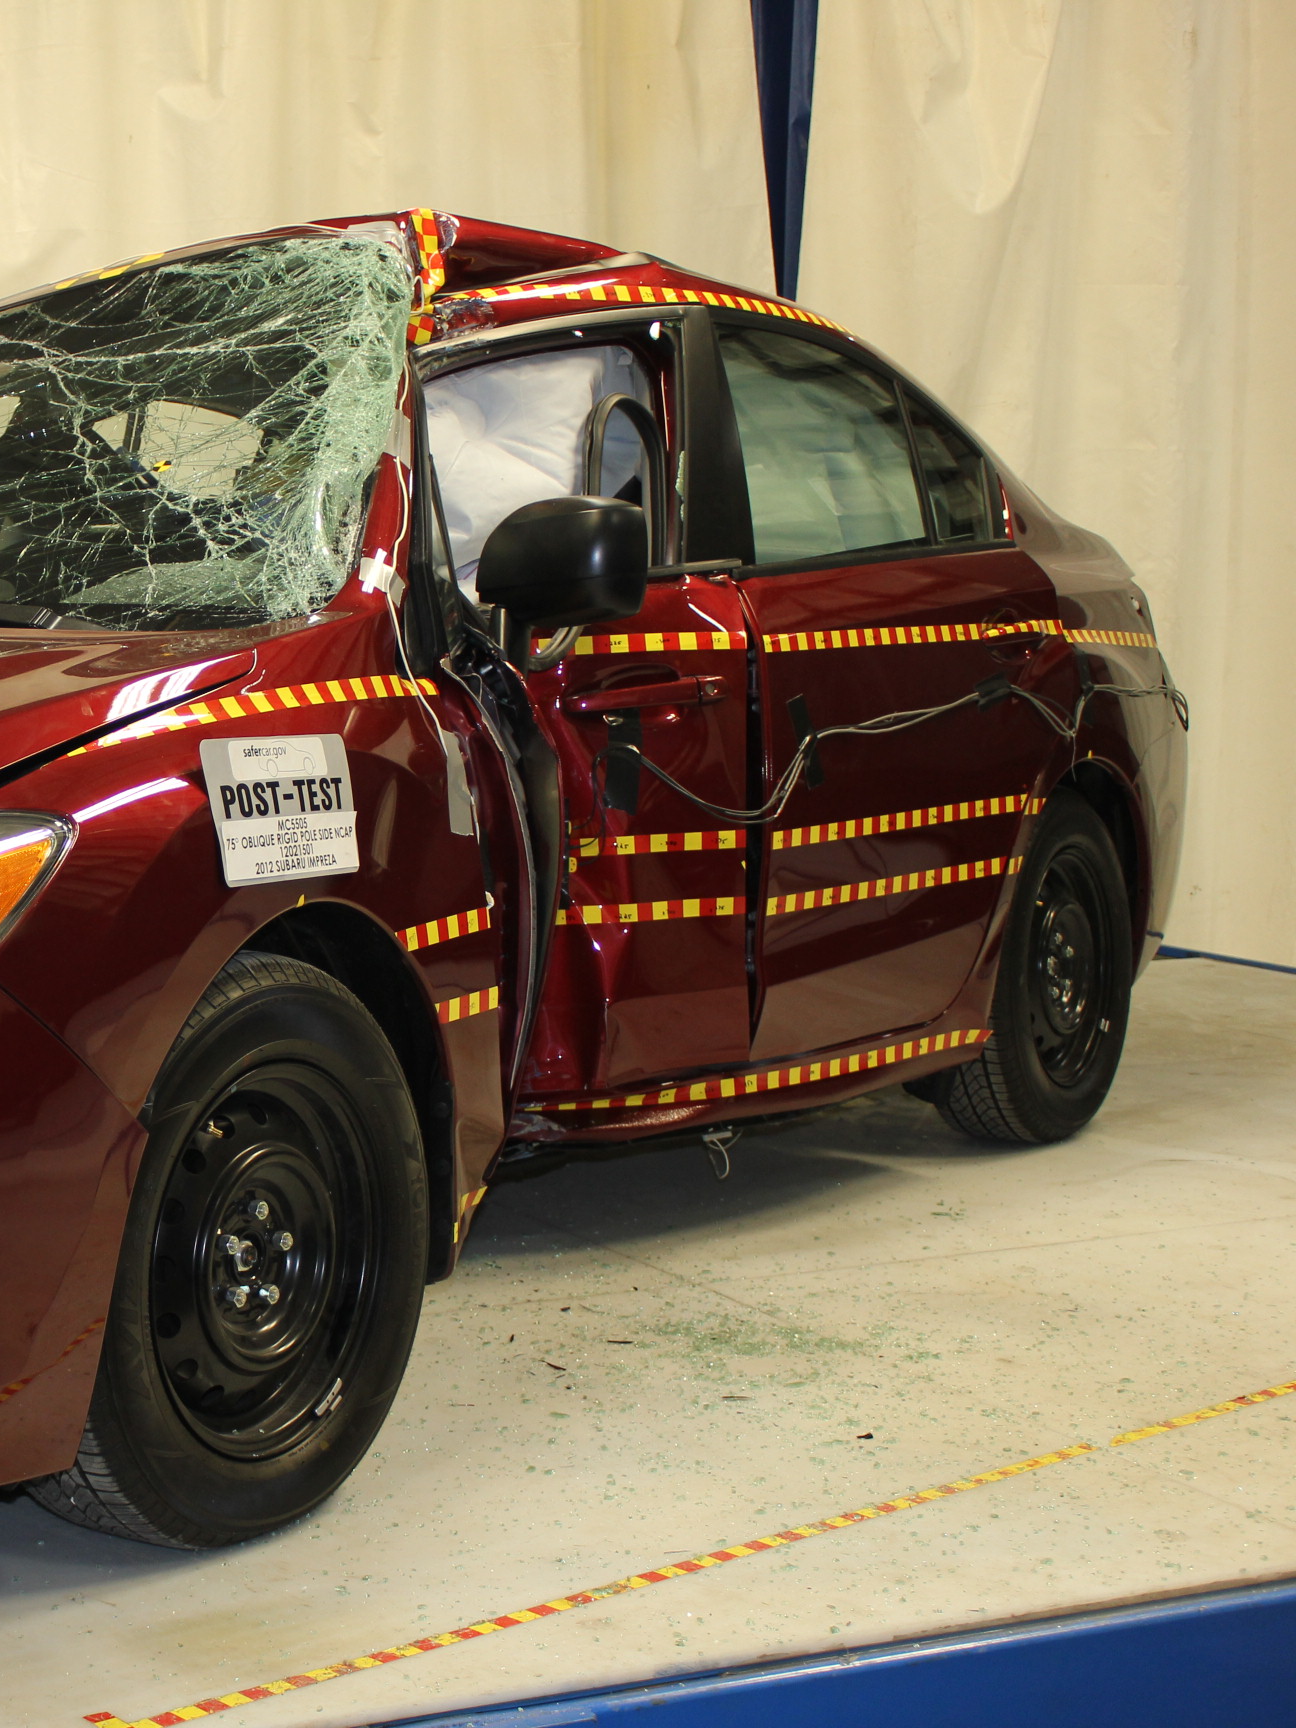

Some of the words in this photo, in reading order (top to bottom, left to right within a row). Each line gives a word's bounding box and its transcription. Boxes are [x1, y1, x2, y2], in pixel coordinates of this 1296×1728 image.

[243, 745, 287, 759] safercar.gov
[220, 777, 342, 819] POST-TEST
[277, 818, 308, 831] MC5505
[241, 834, 275, 848] OBLIQUE
[277, 832, 299, 845] RIGID
[301, 830, 317, 842] POLE
[318, 828, 334, 841] SIDE
[334, 826, 353, 839] NCAP
[279, 843, 314, 858] 12021501
[255, 861, 274, 875] 2012
[275, 857, 306, 872] SUBARU
[307, 854, 337, 868] IMPREZA
